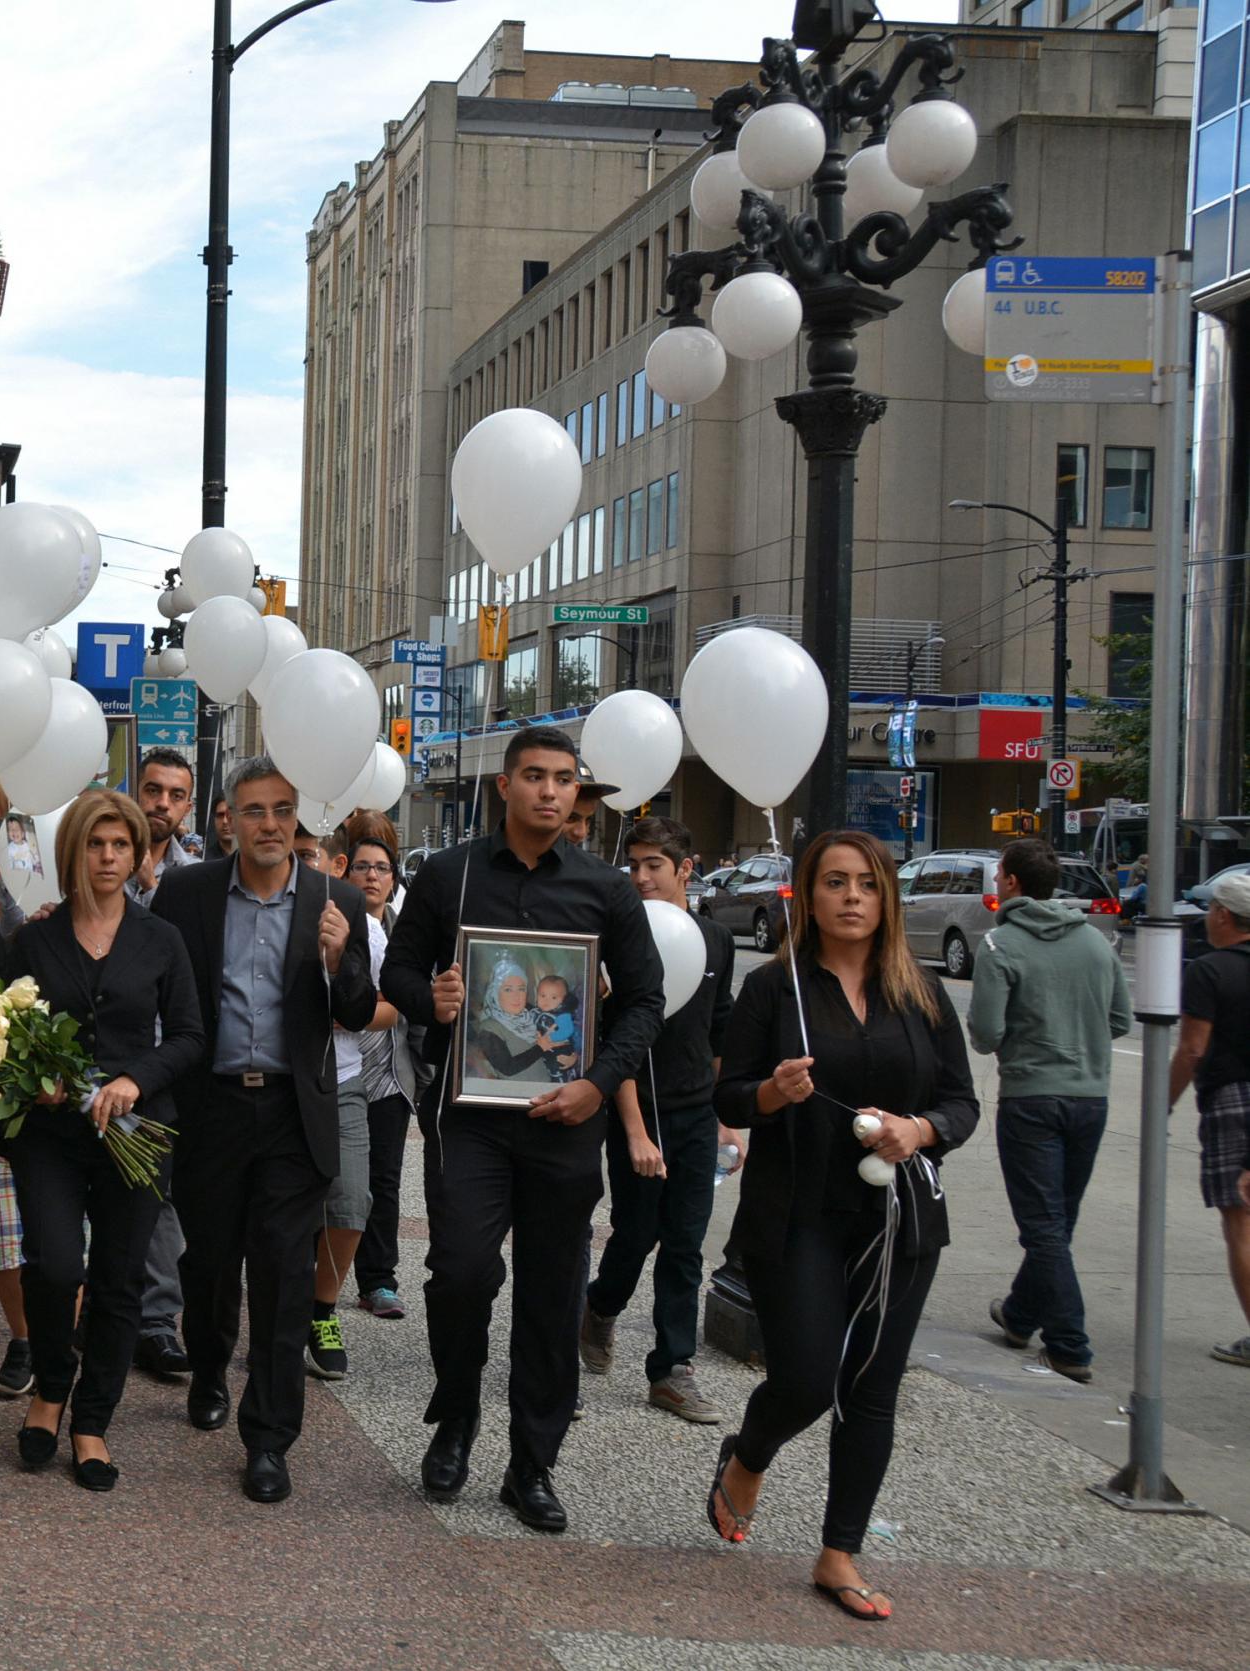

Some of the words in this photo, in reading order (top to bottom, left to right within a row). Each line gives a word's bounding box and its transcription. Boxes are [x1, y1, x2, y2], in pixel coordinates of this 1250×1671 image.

[994, 301, 1012, 313] 44
[560, 607, 621, 621] Seymour
[626, 608, 642, 620] St
[398, 641, 418, 651] Food
[93, 633, 131, 678] T
[406, 651, 413, 661] &
[416, 652, 441, 662] Shops
[1004, 741, 1039, 759] SFU
